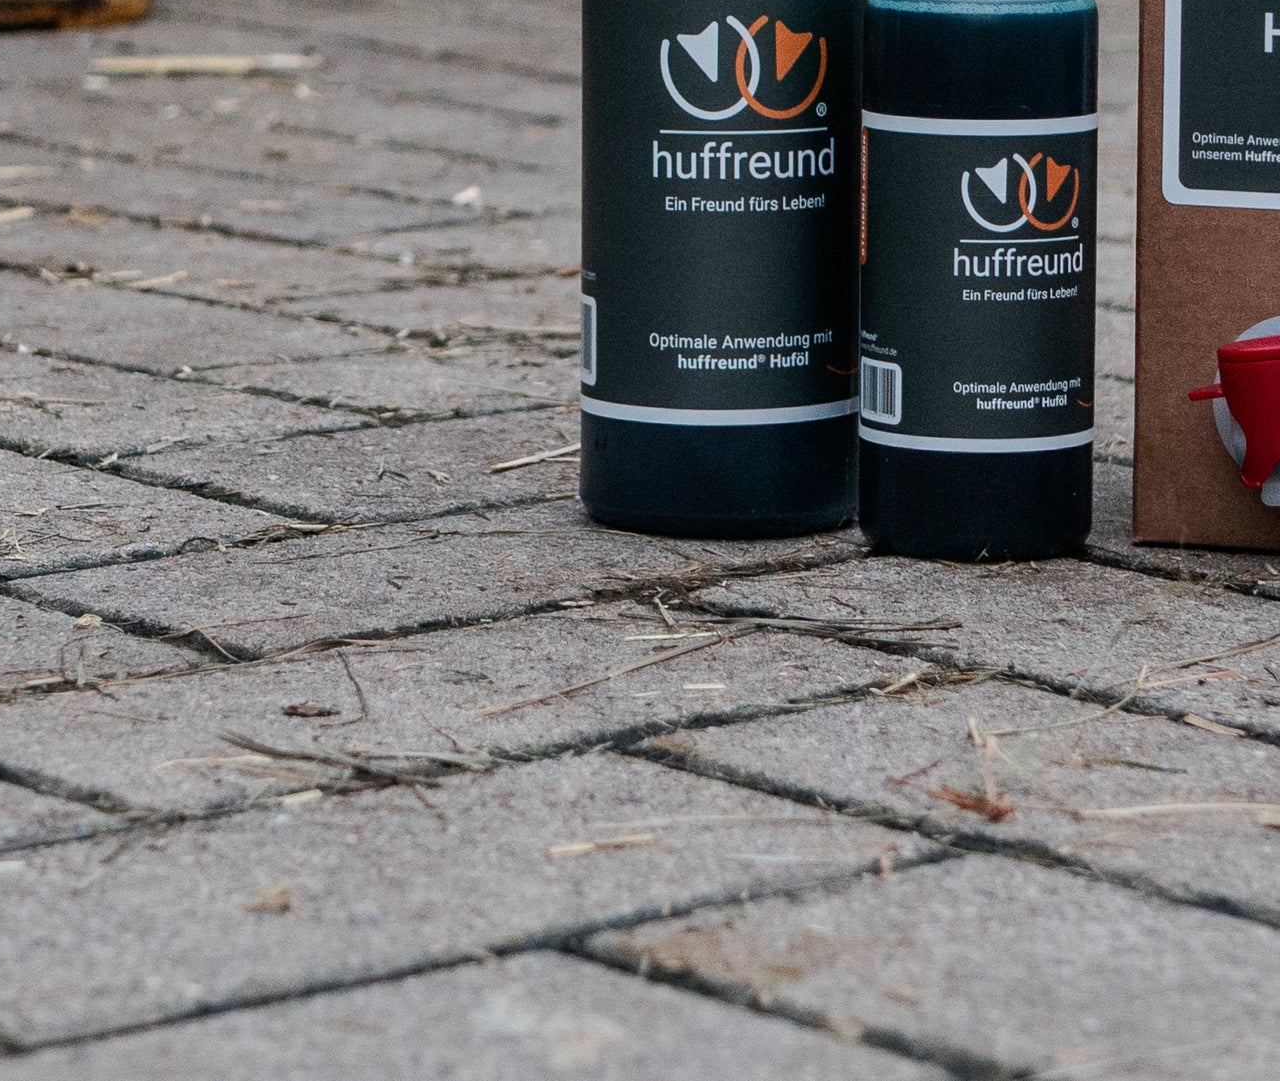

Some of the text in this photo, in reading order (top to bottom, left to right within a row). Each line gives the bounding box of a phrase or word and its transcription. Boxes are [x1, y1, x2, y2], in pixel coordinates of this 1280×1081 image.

[1191, 131, 1245, 146] Optimale
[652, 137, 835, 180] huffreund
[1191, 150, 1243, 161] unserem
[665, 193, 826, 213] Ein Freund fürs Leben!
[953, 243, 1083, 278] huffreund
[962, 285, 1078, 302] Ein Freund fürs Leben!
[649, 329, 833, 353] Optimale Anwendung mit
[769, 350, 810, 369] Huföl
[952, 376, 1081, 396] Optimale Anwendung mit
[1041, 394, 1068, 408] Huföl
